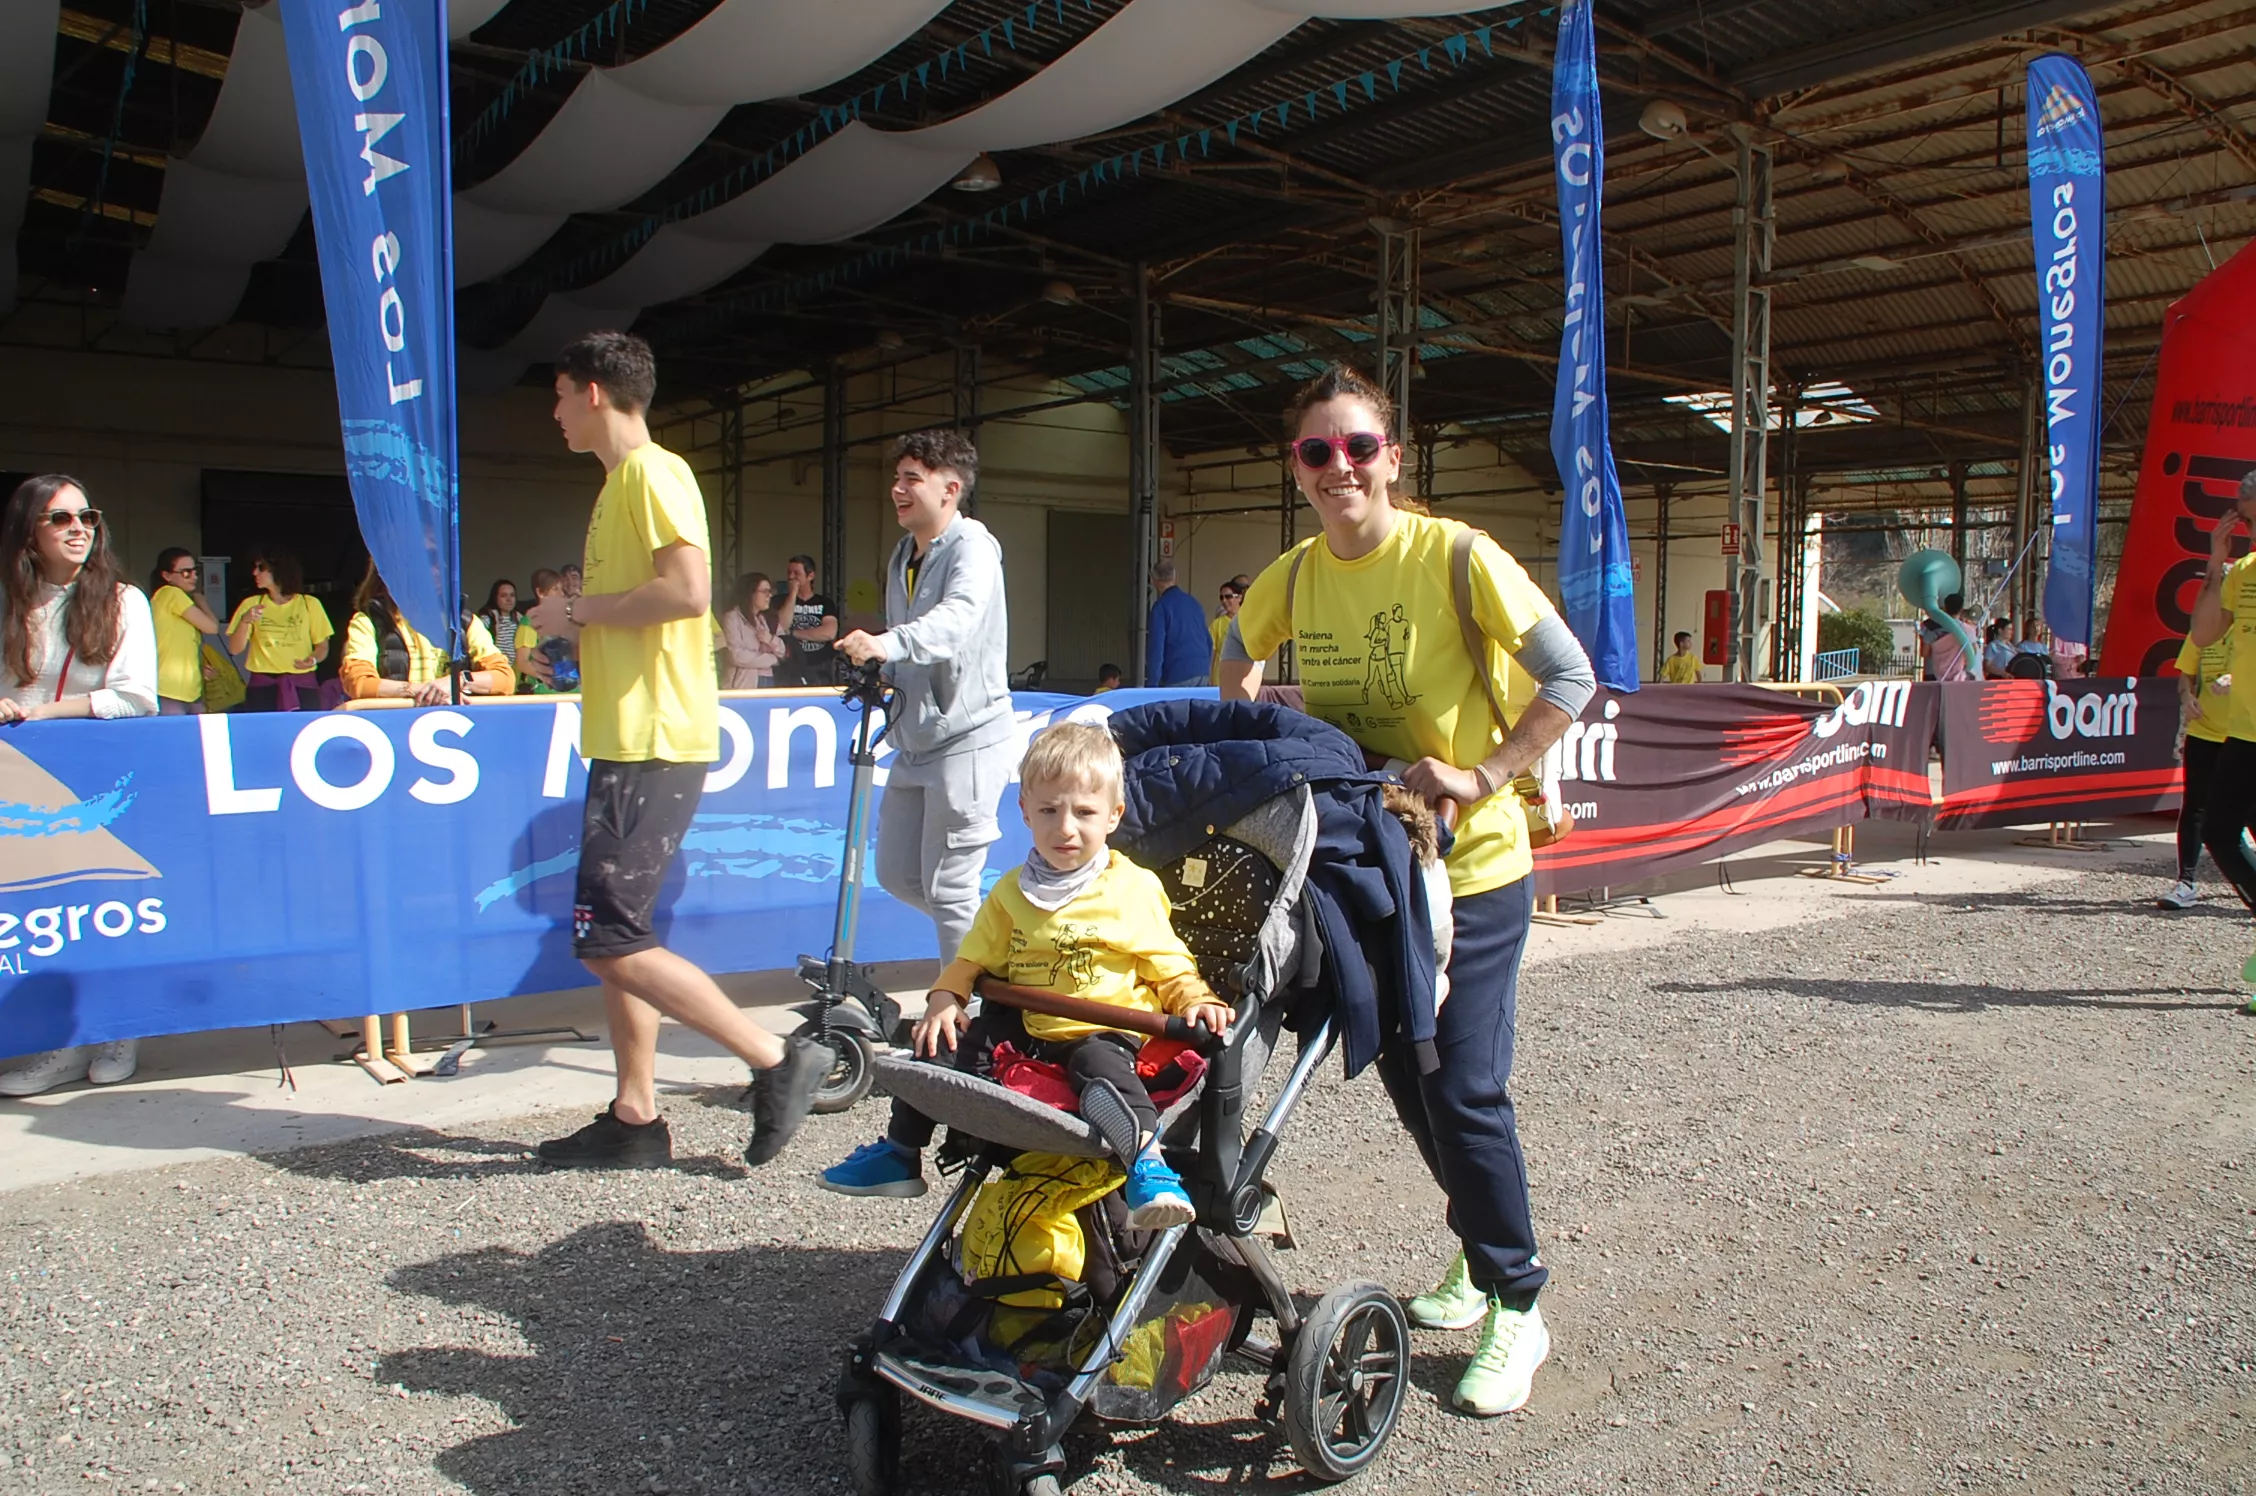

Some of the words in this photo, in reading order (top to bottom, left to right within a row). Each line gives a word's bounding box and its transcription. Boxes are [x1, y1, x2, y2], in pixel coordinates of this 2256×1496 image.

[1162, 522, 1172, 537] P
[1323, 657, 1331, 666] el
[1333, 656, 1361, 666] cáncer
[2045, 676, 2138, 740] barri
[1991, 750, 2126, 776] www.barrisportline.com
